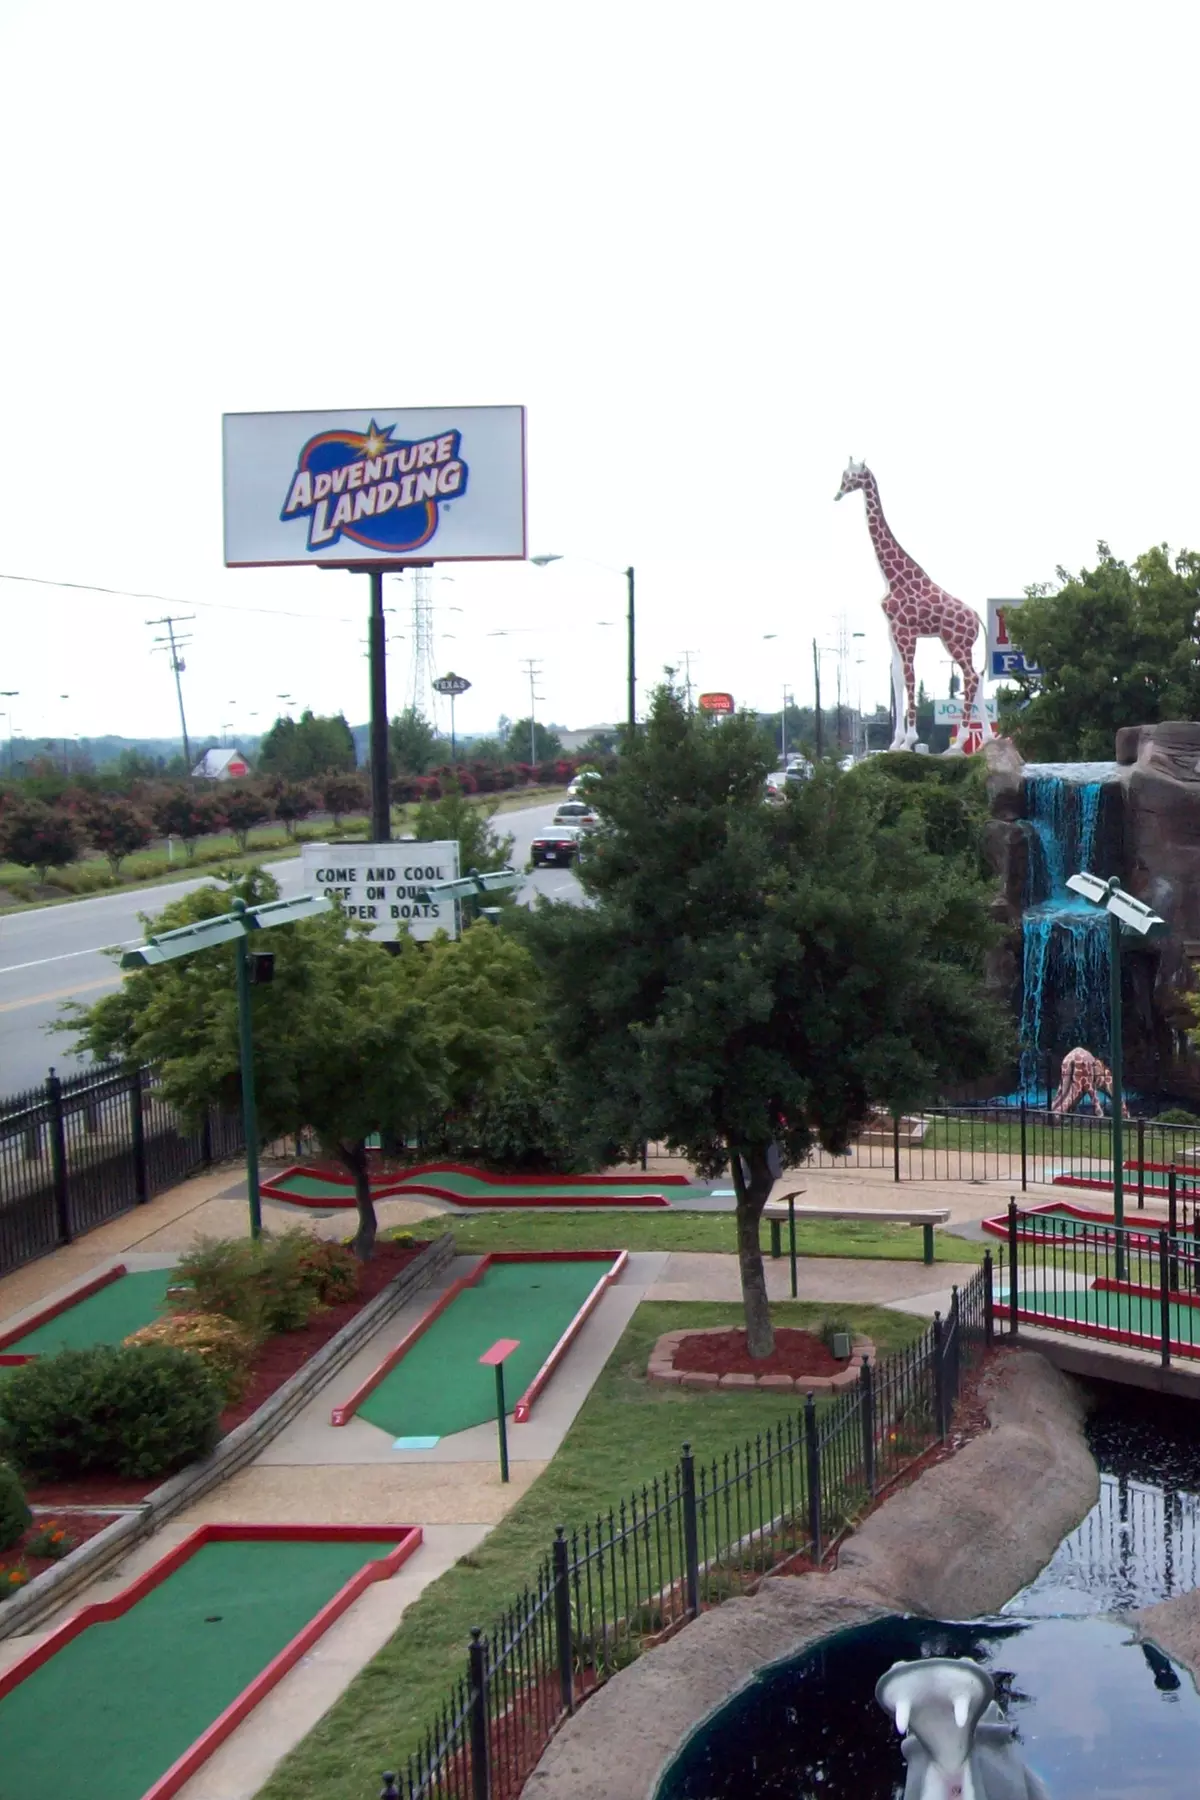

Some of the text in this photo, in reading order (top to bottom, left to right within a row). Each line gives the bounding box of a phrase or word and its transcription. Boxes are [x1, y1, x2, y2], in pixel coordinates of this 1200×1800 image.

[285, 433, 454, 513] ADVENTURE
[308, 460, 462, 544] LANDING
[316, 866, 445, 883] COME AND COOL
[366, 886, 386, 900] ON
[390, 904, 440, 919] BOATS
